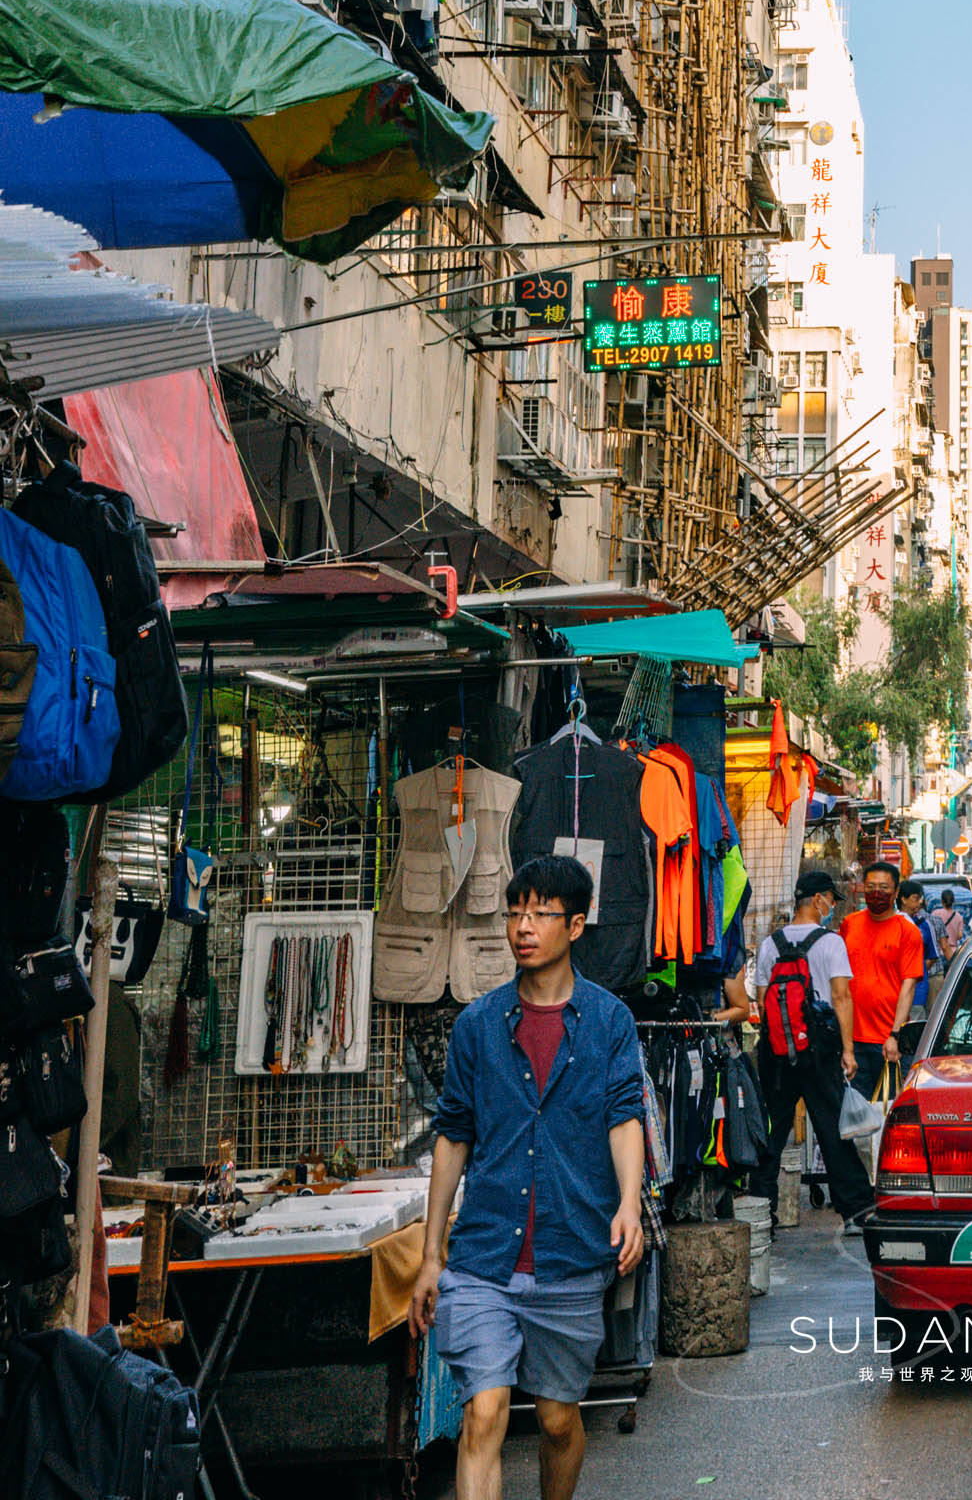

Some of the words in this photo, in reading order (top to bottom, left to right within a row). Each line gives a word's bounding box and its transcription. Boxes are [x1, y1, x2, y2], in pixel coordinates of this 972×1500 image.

[809, 158, 833, 285] 龍祥大廈
[521, 280, 568, 299] 230
[612, 284, 694, 322] 愉康
[528, 304, 566, 325] 一樓
[592, 346, 670, 365] TEL:2907
[674, 343, 713, 361] 1419
[864, 492, 888, 613] 祥大廈
[927, 1113, 959, 1121] TOYOTA
